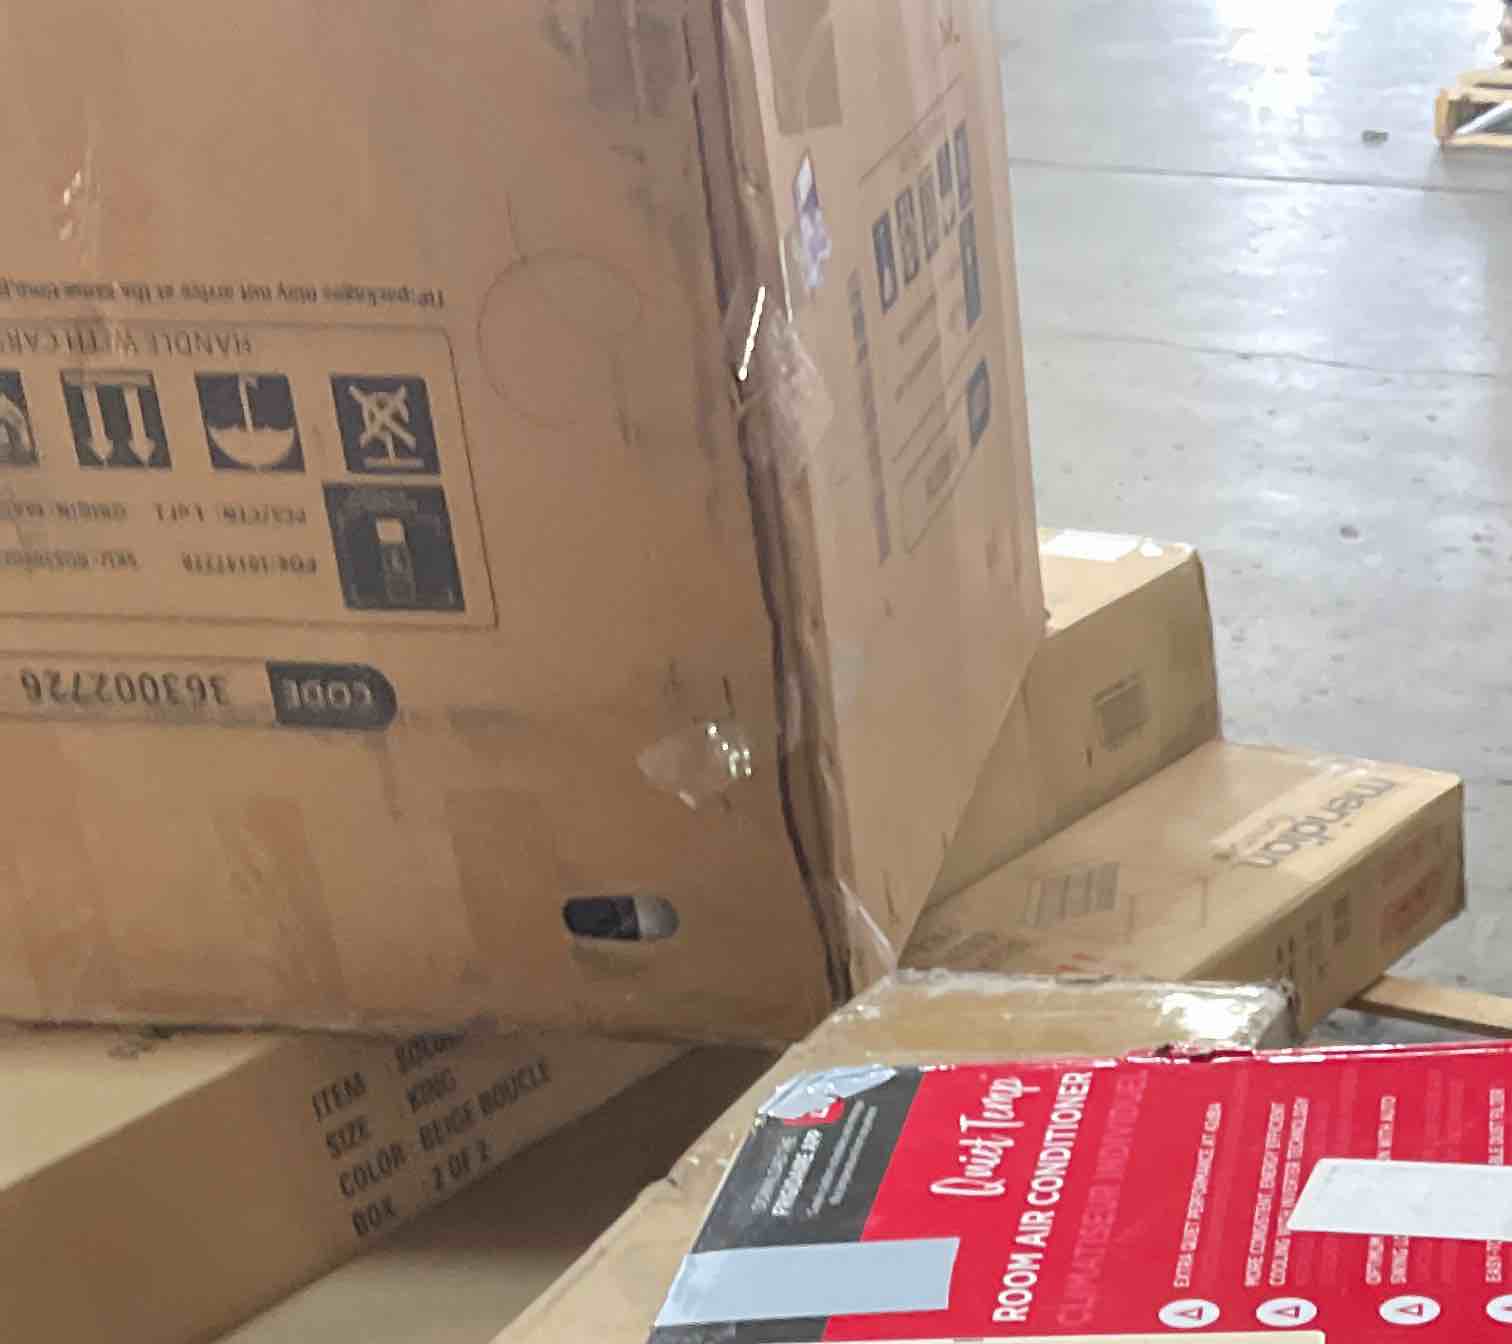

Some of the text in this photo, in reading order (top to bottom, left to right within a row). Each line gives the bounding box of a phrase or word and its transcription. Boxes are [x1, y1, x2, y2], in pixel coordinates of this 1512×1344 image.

[991, 1071, 1094, 1323] ROOM AIR CONDITIONER
